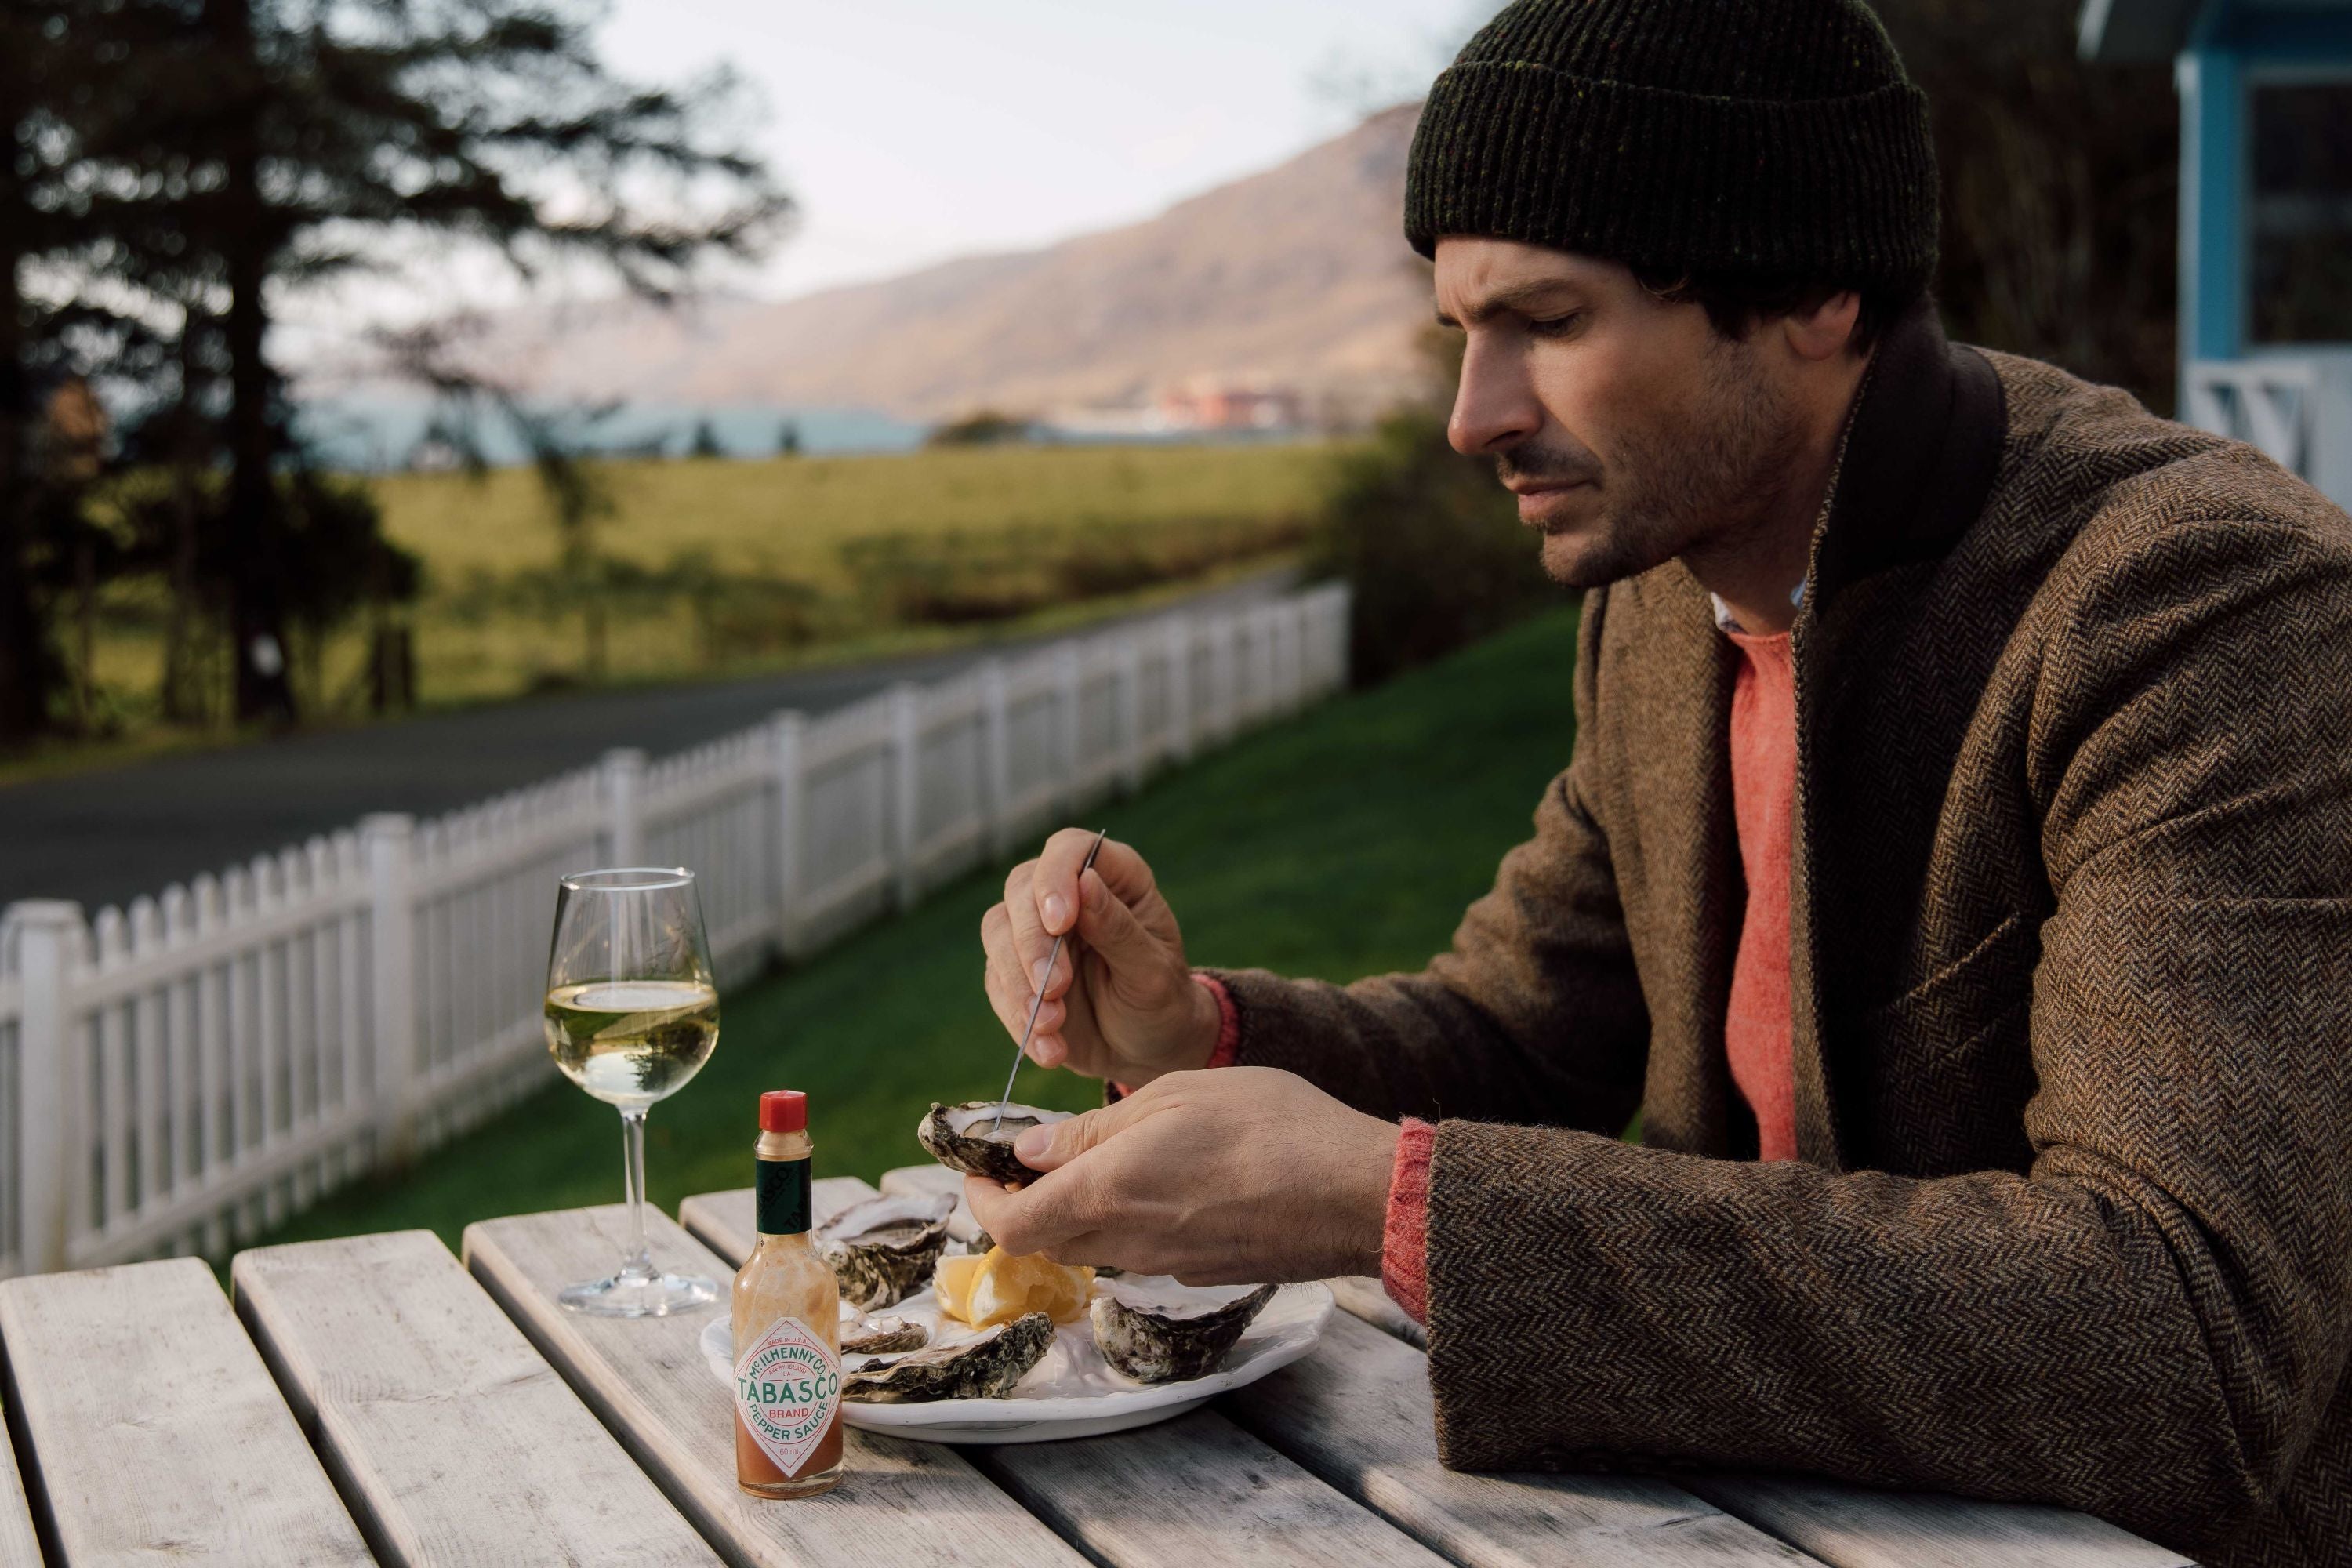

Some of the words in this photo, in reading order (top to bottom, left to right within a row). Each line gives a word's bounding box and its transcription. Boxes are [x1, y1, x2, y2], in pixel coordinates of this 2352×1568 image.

[768, 1365, 786, 1375] AVERY
[787, 1364, 807, 1374] ISLAND
[738, 1372, 837, 1403] TABASCO
[749, 1403, 791, 1440] PEPPER
[794, 1401, 828, 1439] SAUCE
[769, 1408, 809, 1418] BRAND
